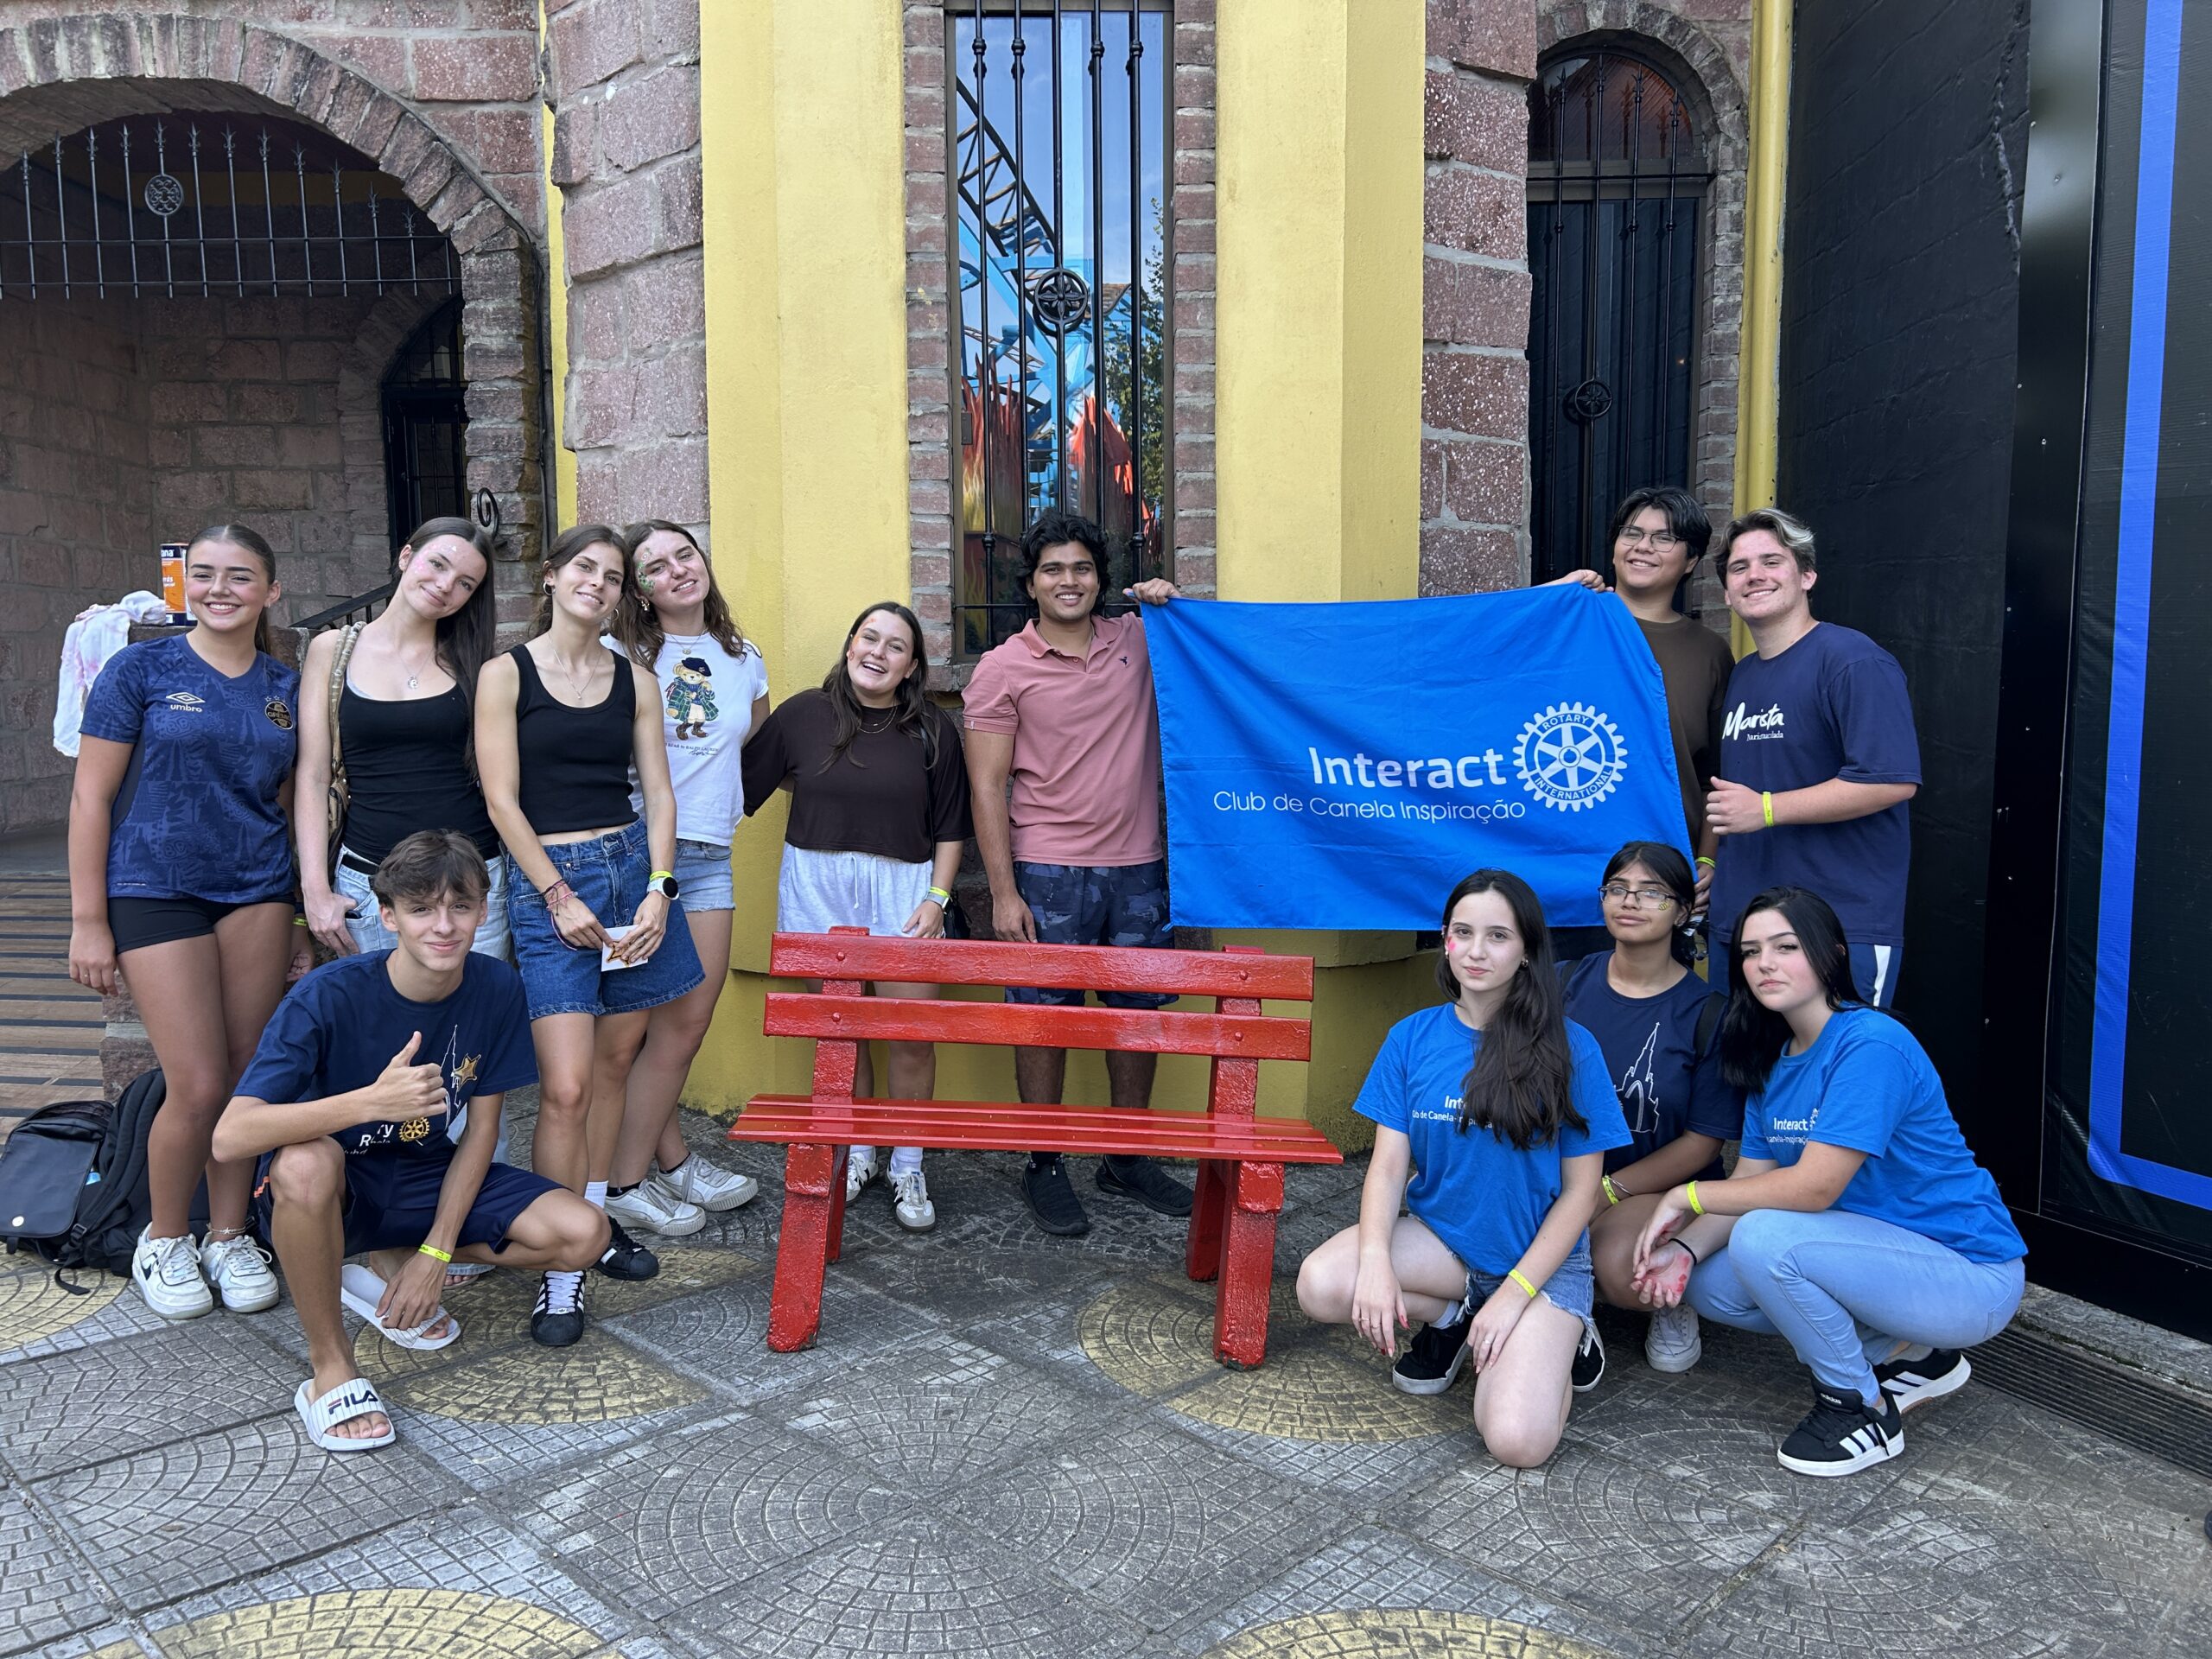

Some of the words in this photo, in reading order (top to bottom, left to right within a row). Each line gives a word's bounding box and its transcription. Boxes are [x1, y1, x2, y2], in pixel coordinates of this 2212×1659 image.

[170, 704, 202, 713] umbro
[1541, 714, 1590, 731] ROTARY
[1722, 702, 1785, 741] Marista
[1308, 747, 1507, 789] Interact
[1535, 769, 1612, 800] INTERNATIONAL
[1213, 791, 1267, 810] Club
[1273, 792, 1303, 812] de
[1309, 797, 1396, 818] Canela
[1400, 799, 1526, 824] Inspiração
[1773, 1117, 1808, 1131] Interact
[327, 1389, 378, 1414] FILA
